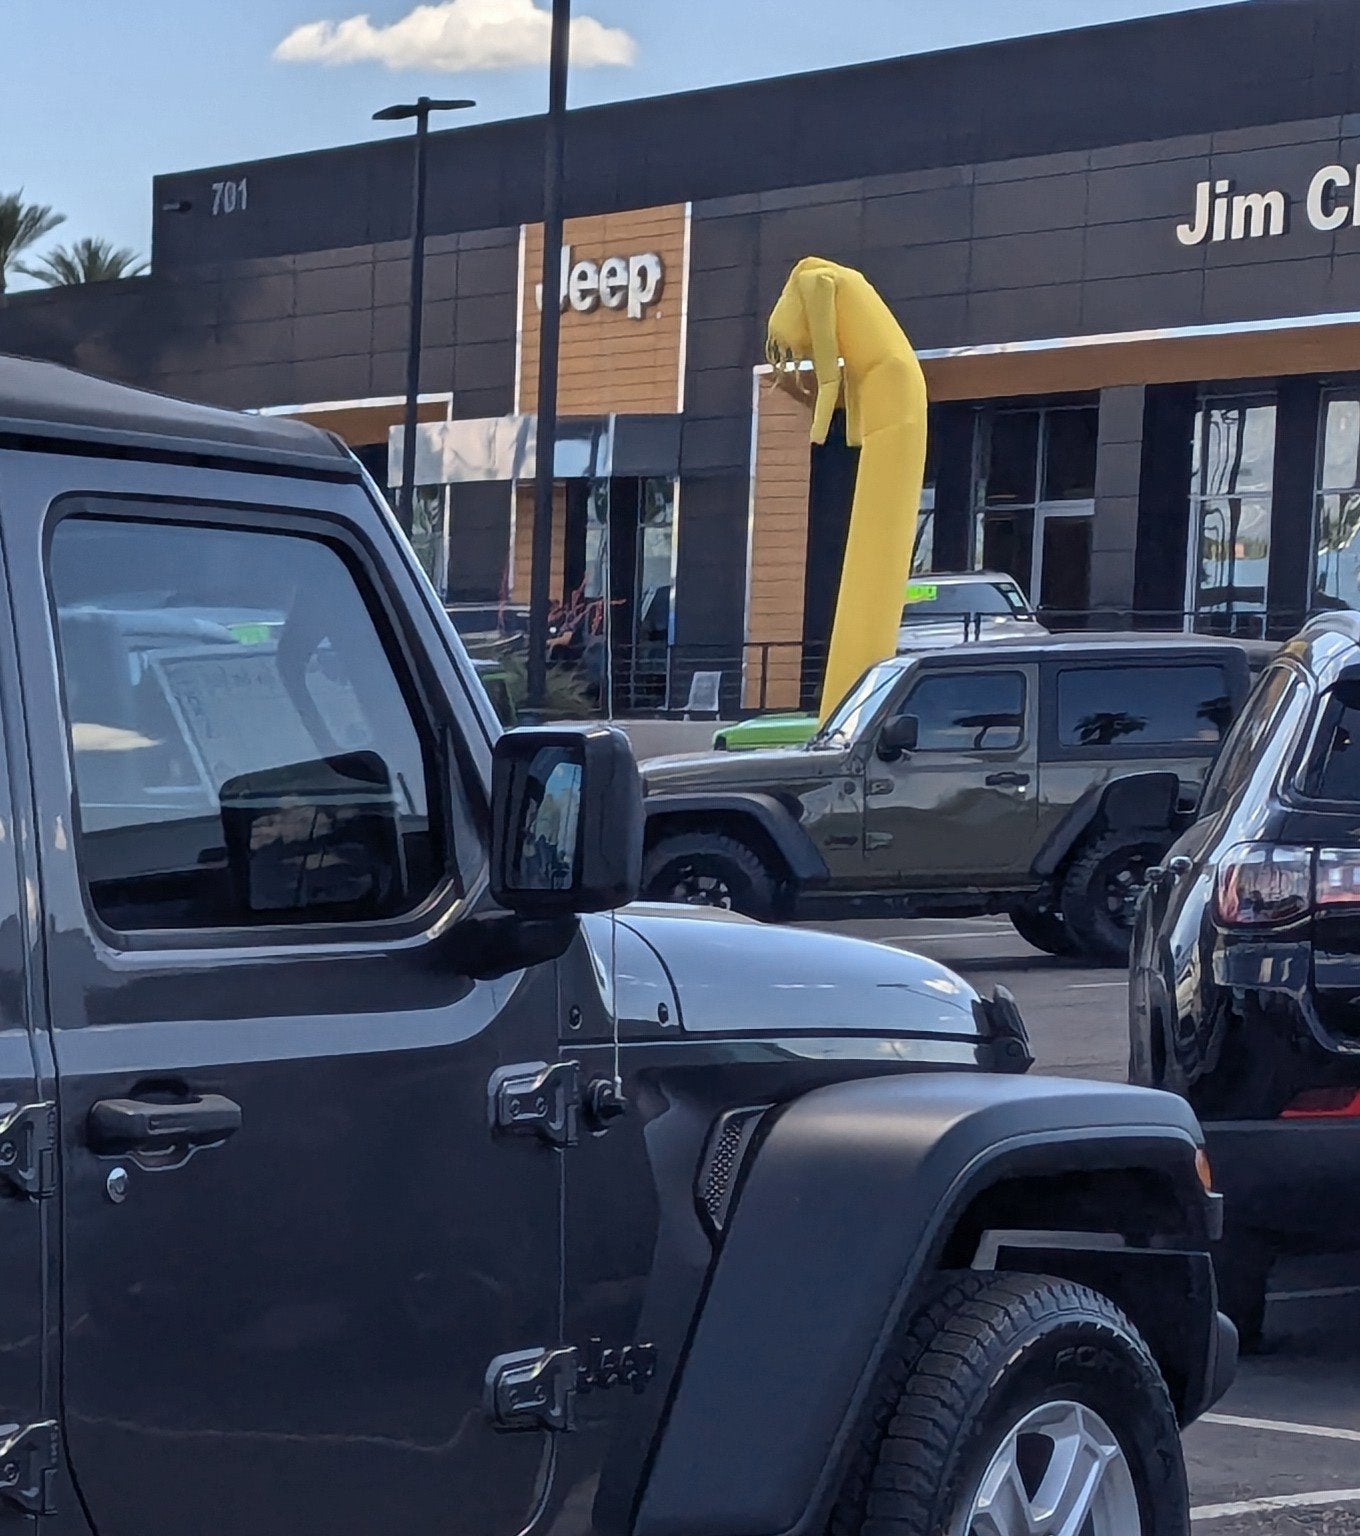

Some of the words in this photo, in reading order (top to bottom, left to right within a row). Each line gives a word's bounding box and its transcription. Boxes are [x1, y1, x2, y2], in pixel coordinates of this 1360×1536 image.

[211, 177, 248, 216] 701
[1176, 179, 1285, 246] Jim
[535, 243, 662, 320] Jeep
